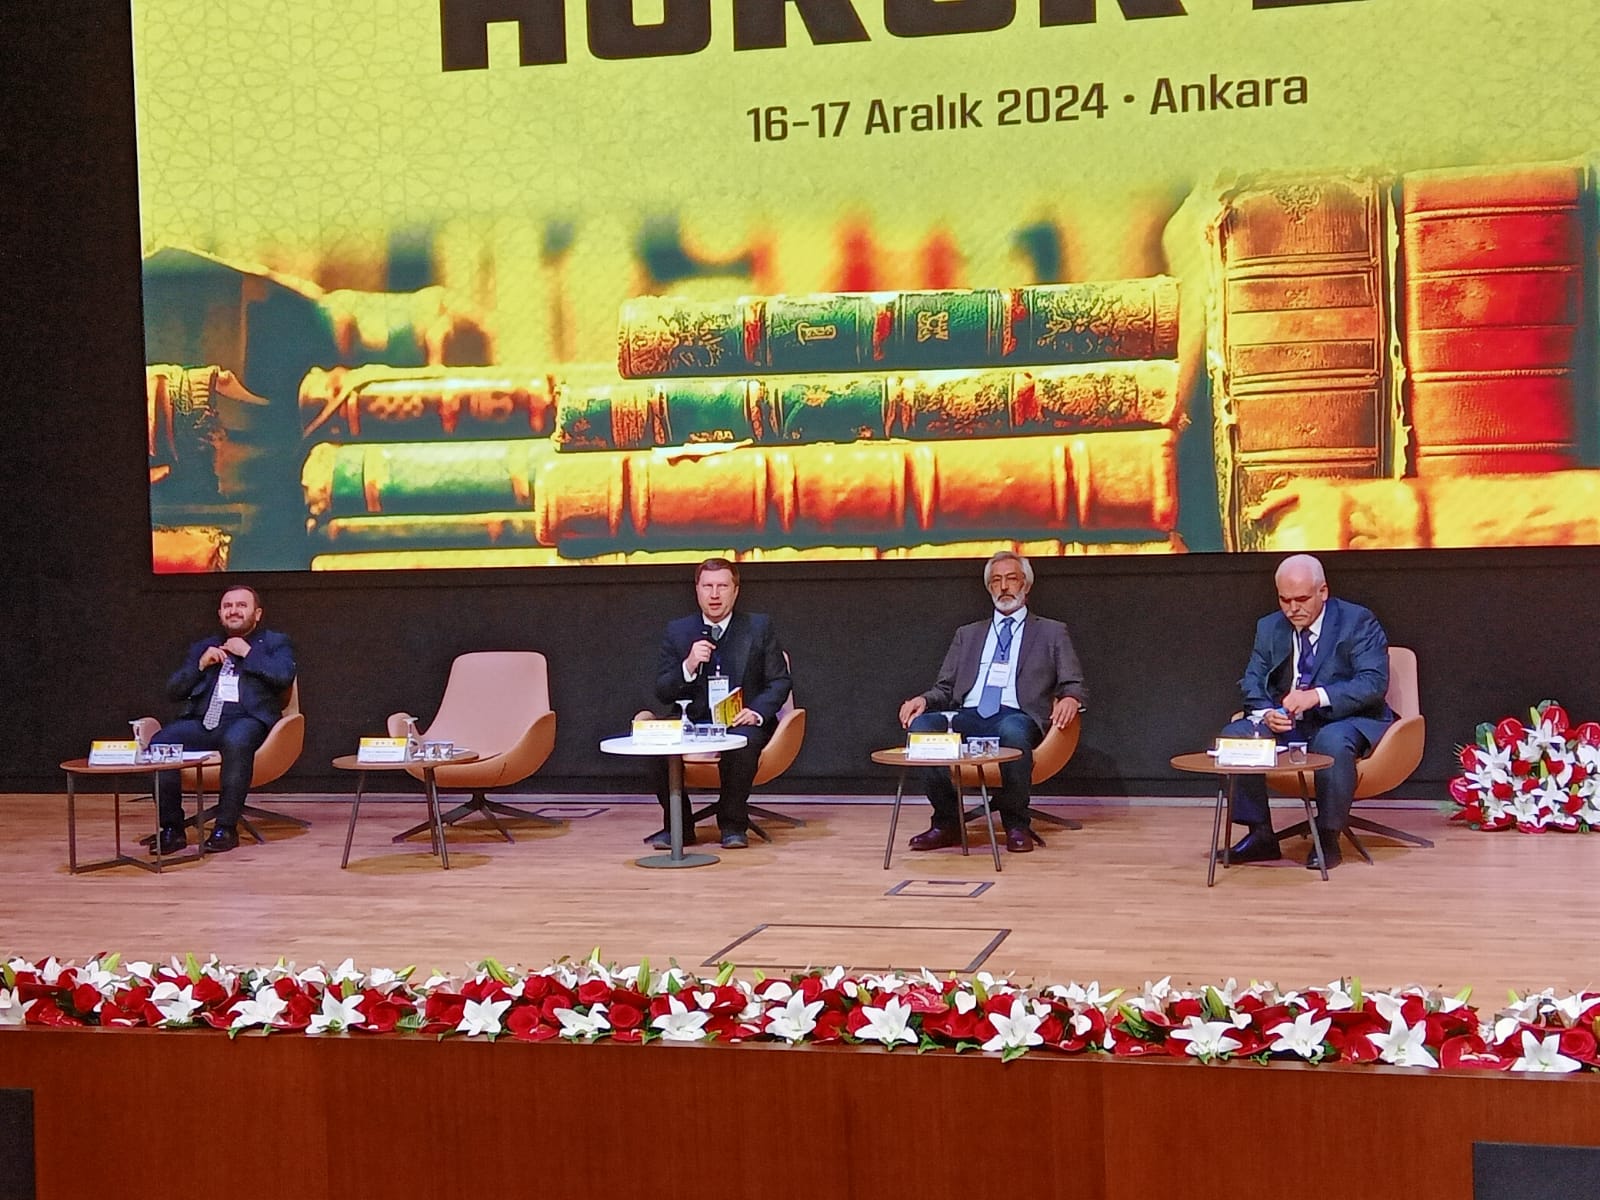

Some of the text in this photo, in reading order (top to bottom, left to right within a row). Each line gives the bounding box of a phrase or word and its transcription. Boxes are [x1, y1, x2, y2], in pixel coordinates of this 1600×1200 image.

[746, 73, 1308, 143] 16-17 Aralık 2024 Ankara
